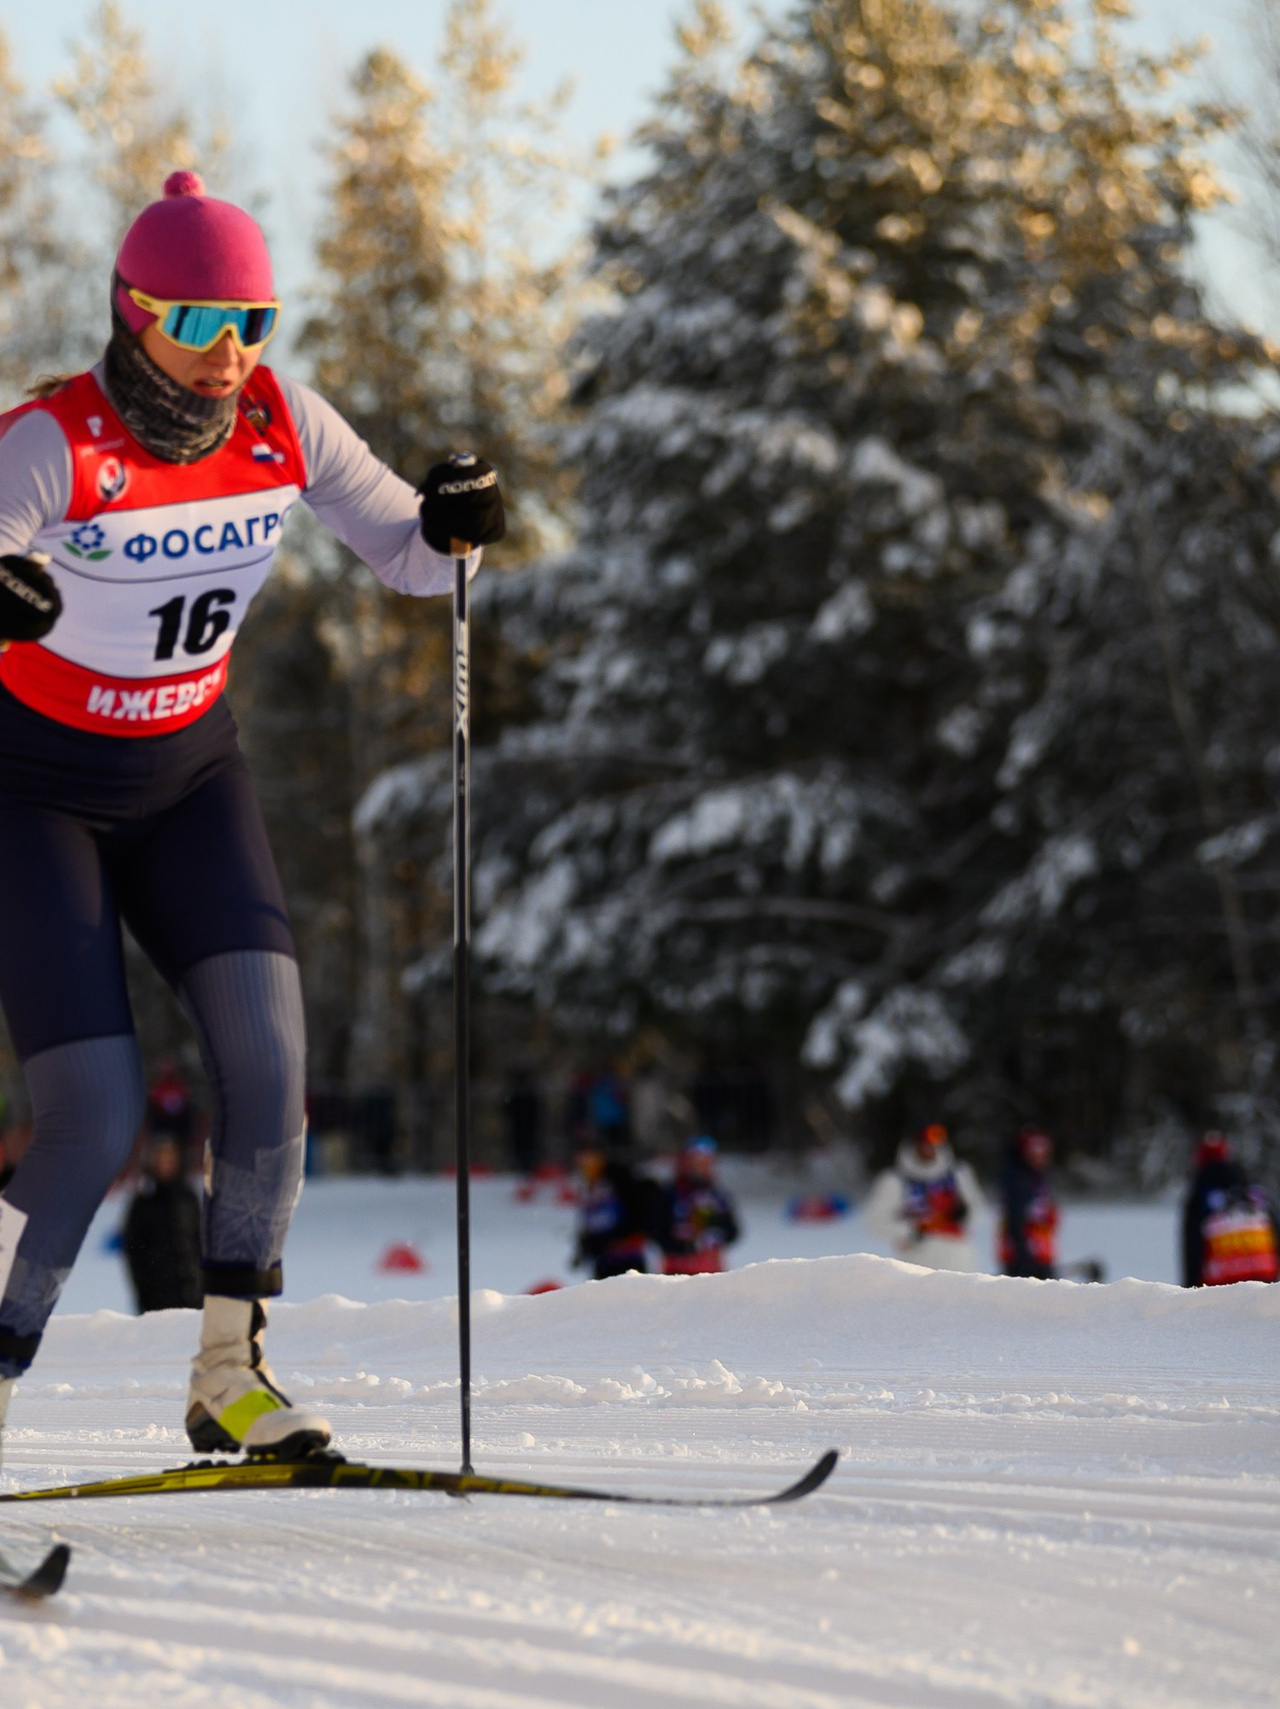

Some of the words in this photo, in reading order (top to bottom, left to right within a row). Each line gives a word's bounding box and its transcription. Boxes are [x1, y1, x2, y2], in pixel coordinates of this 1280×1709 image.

[438, 470, 497, 494] nonam
[123, 512, 286, 563] ФОСАГР
[149, 588, 236, 661] 16
